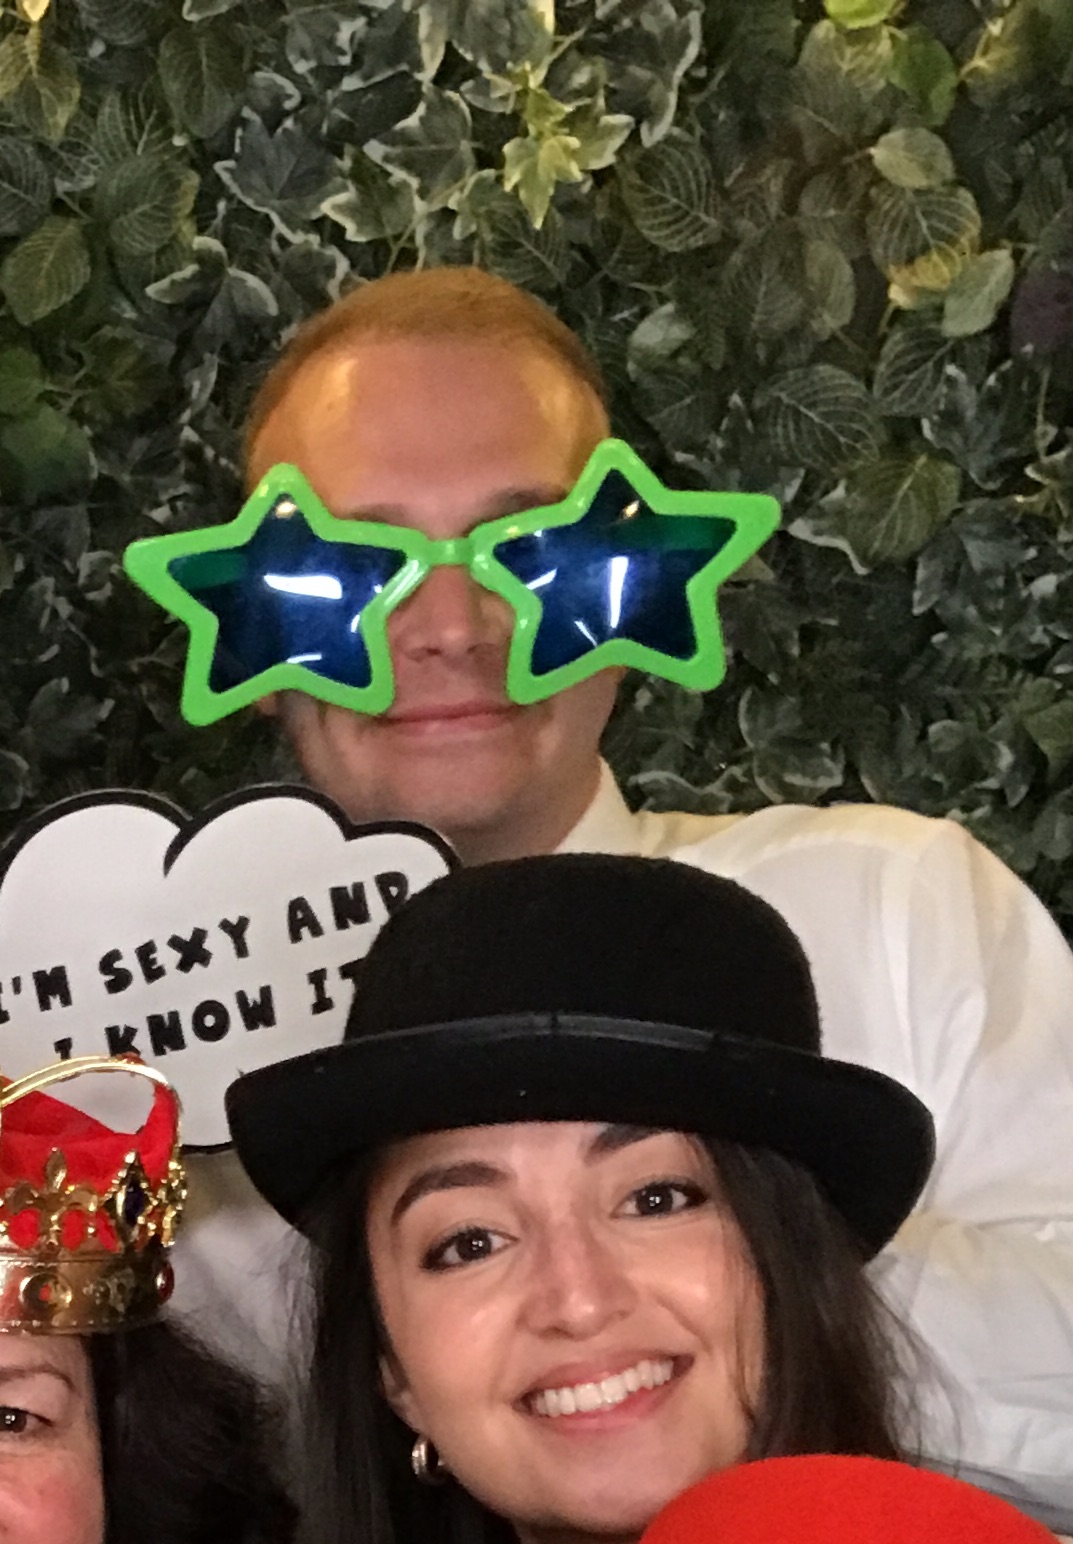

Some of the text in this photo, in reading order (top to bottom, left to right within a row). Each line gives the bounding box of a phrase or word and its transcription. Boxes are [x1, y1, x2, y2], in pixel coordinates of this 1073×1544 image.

[98, 916, 250, 994] SEXY
[288, 871, 408, 943] AND
[104, 985, 276, 1058] KNOW
